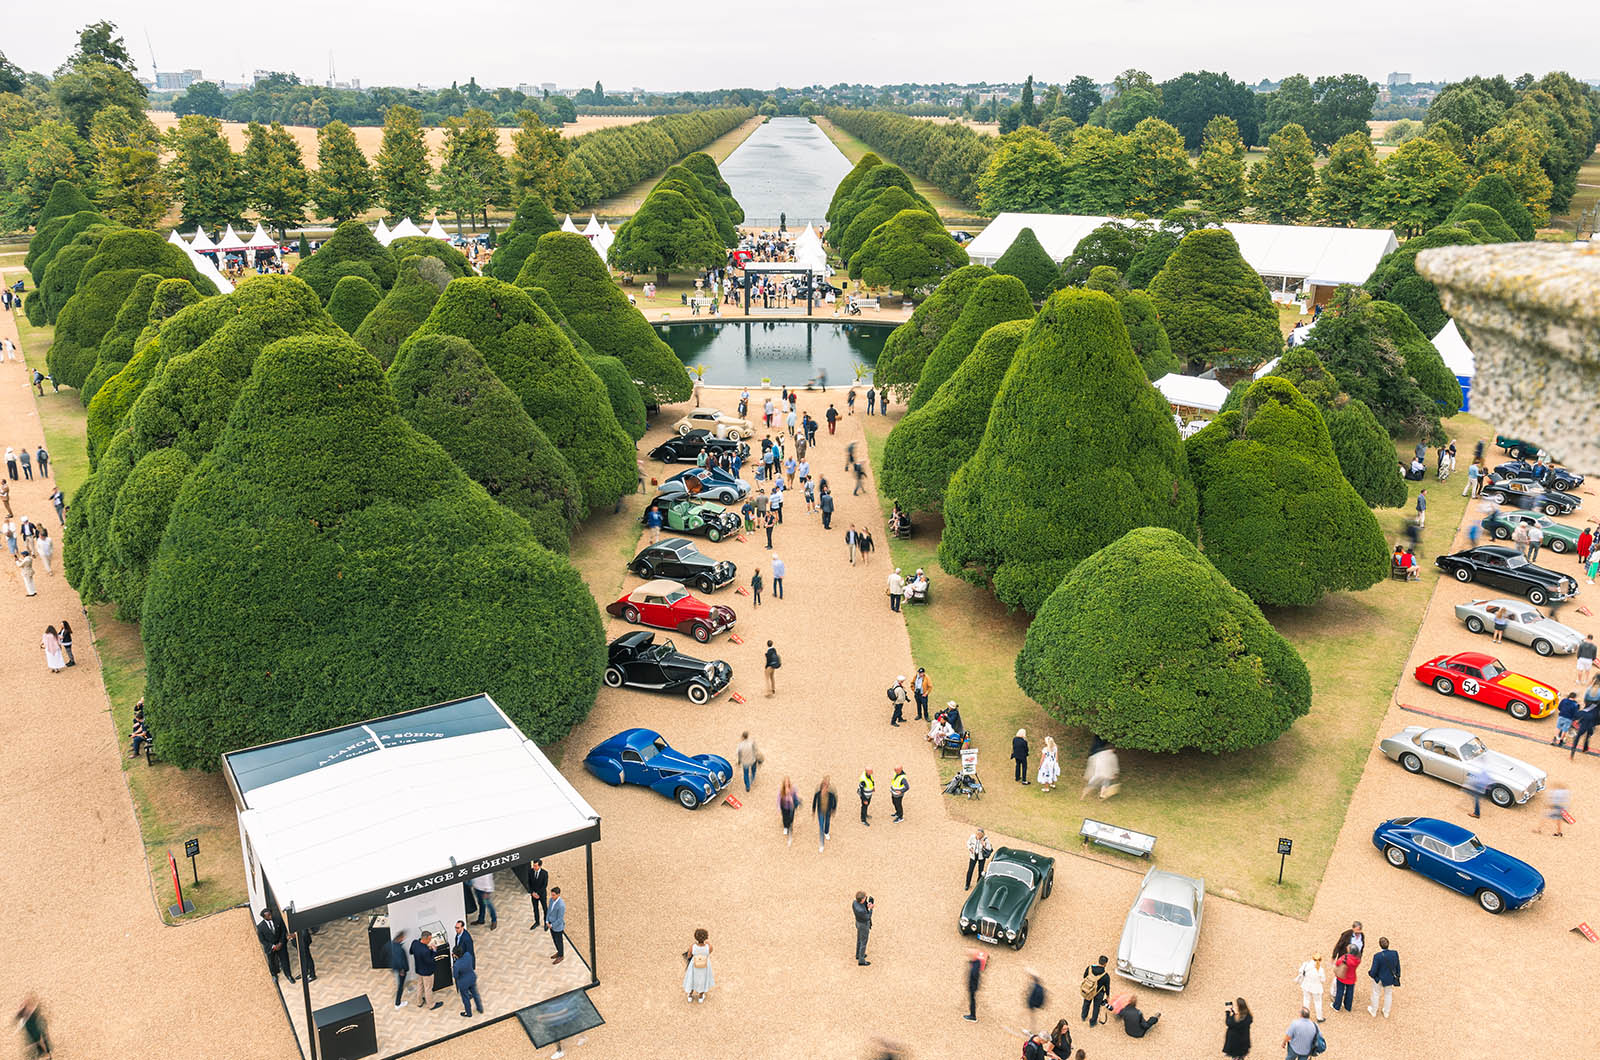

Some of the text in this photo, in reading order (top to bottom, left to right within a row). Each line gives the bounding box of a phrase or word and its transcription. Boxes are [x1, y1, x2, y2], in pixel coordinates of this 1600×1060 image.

[1464, 680, 1478, 695] 54
[386, 852, 520, 899] A. LANGE & SÖHNE
